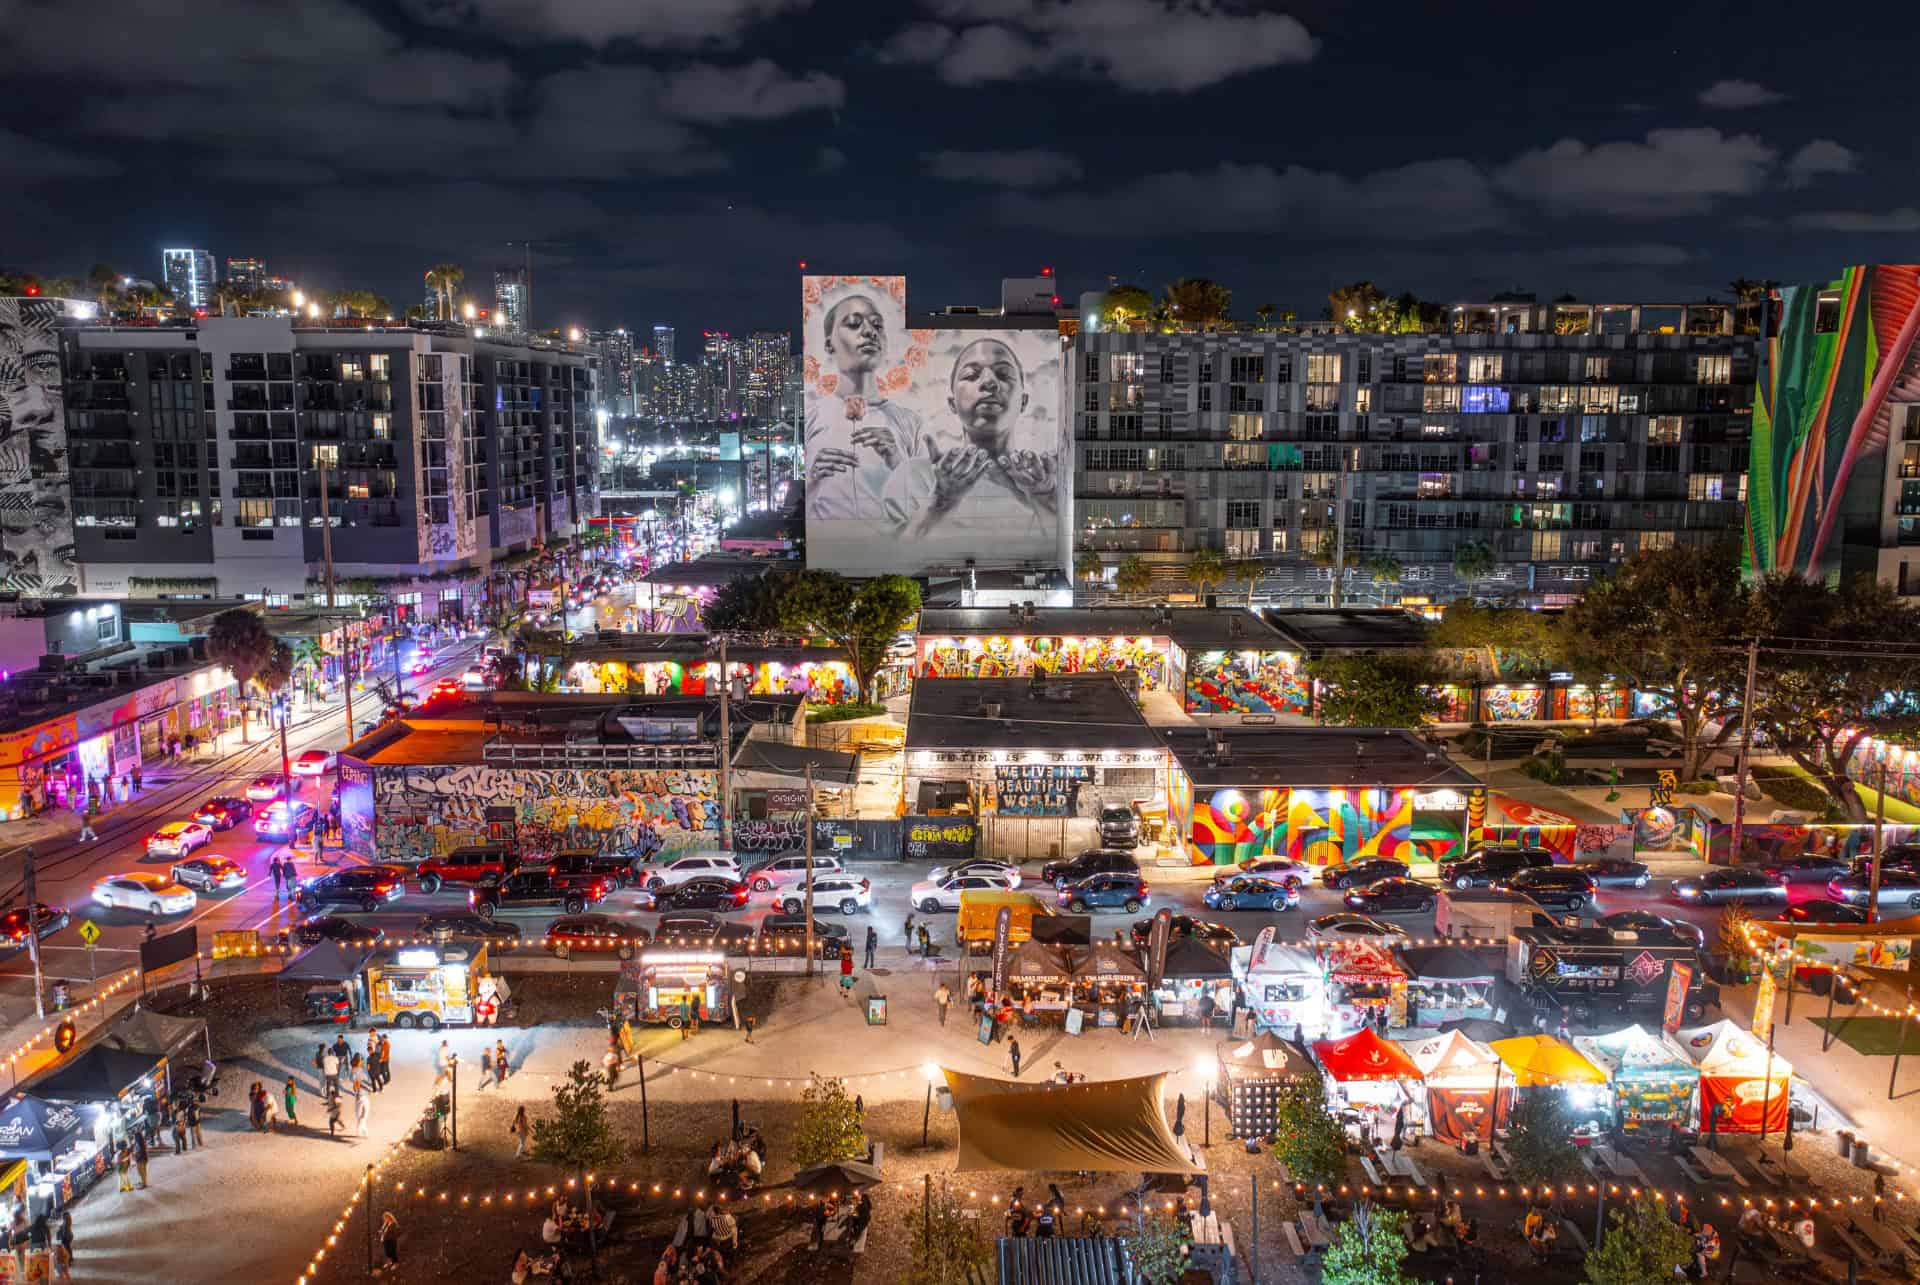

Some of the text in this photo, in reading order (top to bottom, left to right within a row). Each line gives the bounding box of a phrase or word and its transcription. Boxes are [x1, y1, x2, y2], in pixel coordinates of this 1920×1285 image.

[999, 766, 1088, 779] WE LIVE IN A
[997, 779, 1073, 793] BEAUTIFUL
[1003, 794, 1068, 809] WORLD
[996, 922, 1006, 992] OYSTERS
